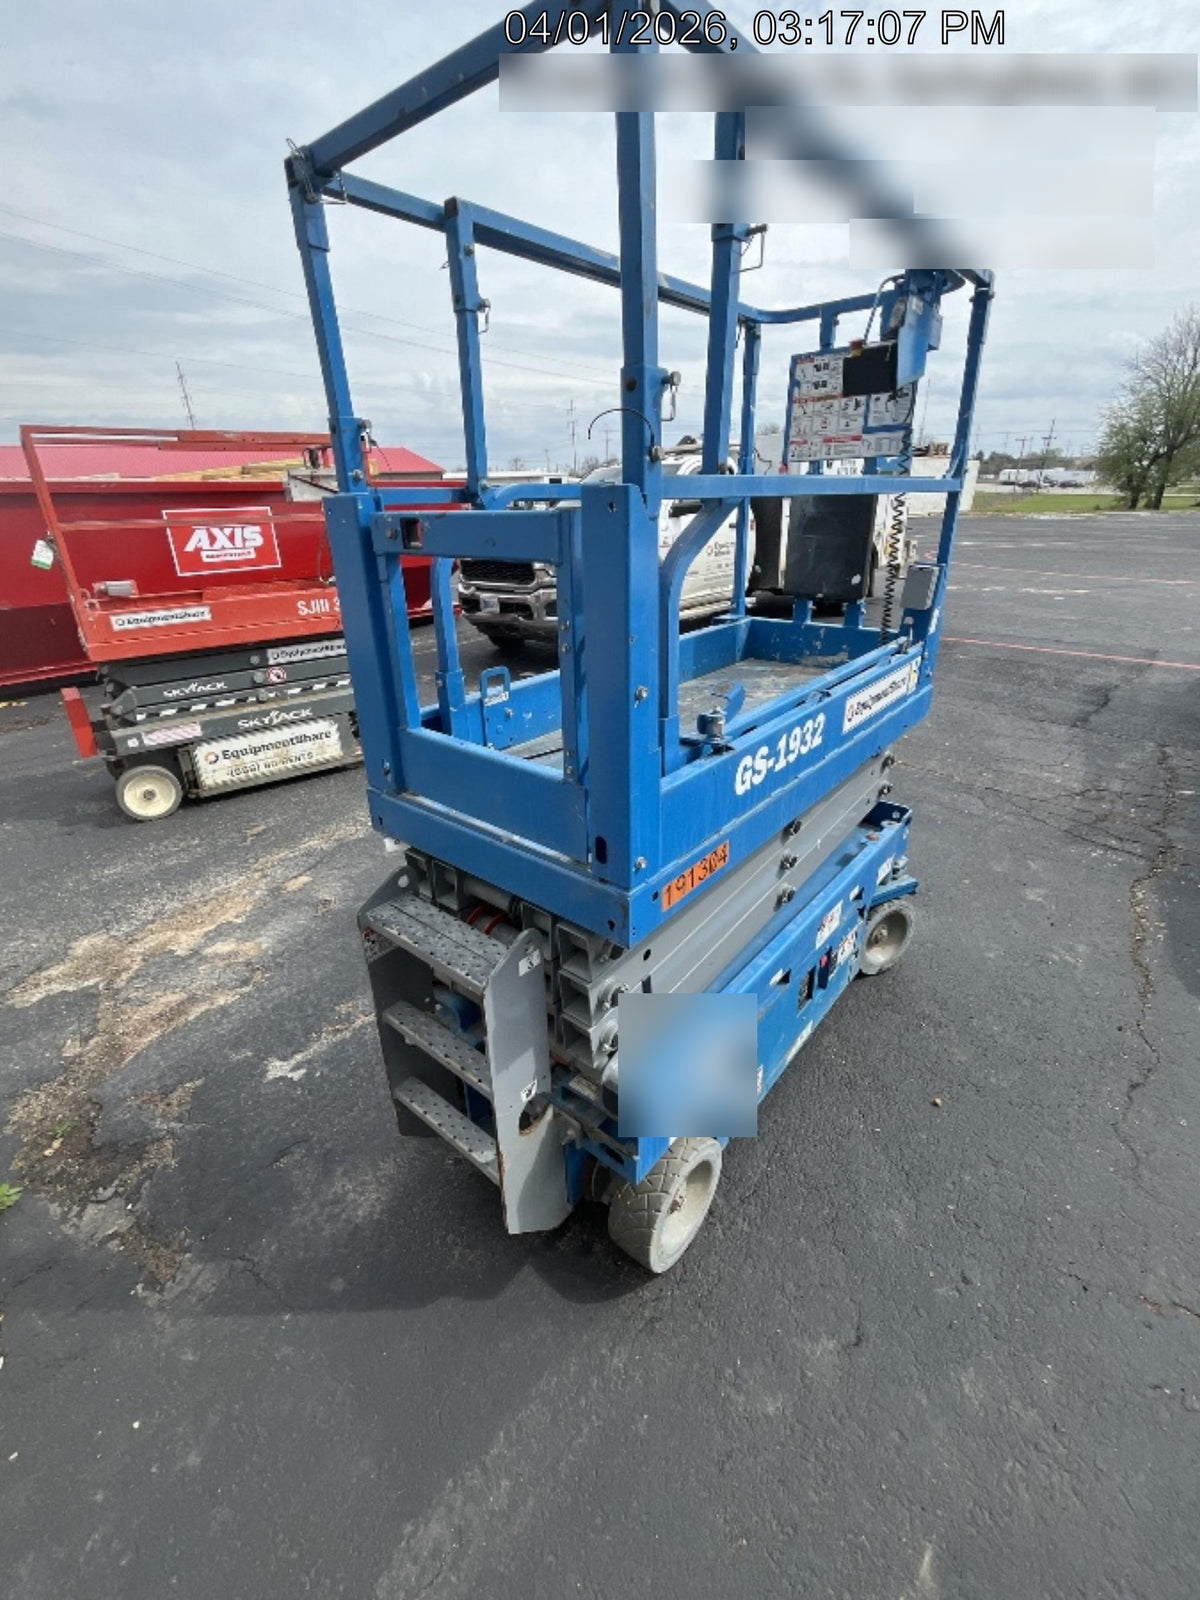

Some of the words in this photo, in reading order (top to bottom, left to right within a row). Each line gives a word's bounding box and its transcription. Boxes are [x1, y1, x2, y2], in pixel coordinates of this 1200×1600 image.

[184, 525, 264, 552] AXIS
[221, 729, 333, 761] EquipmentShare
[734, 712, 826, 796] GS-1932
